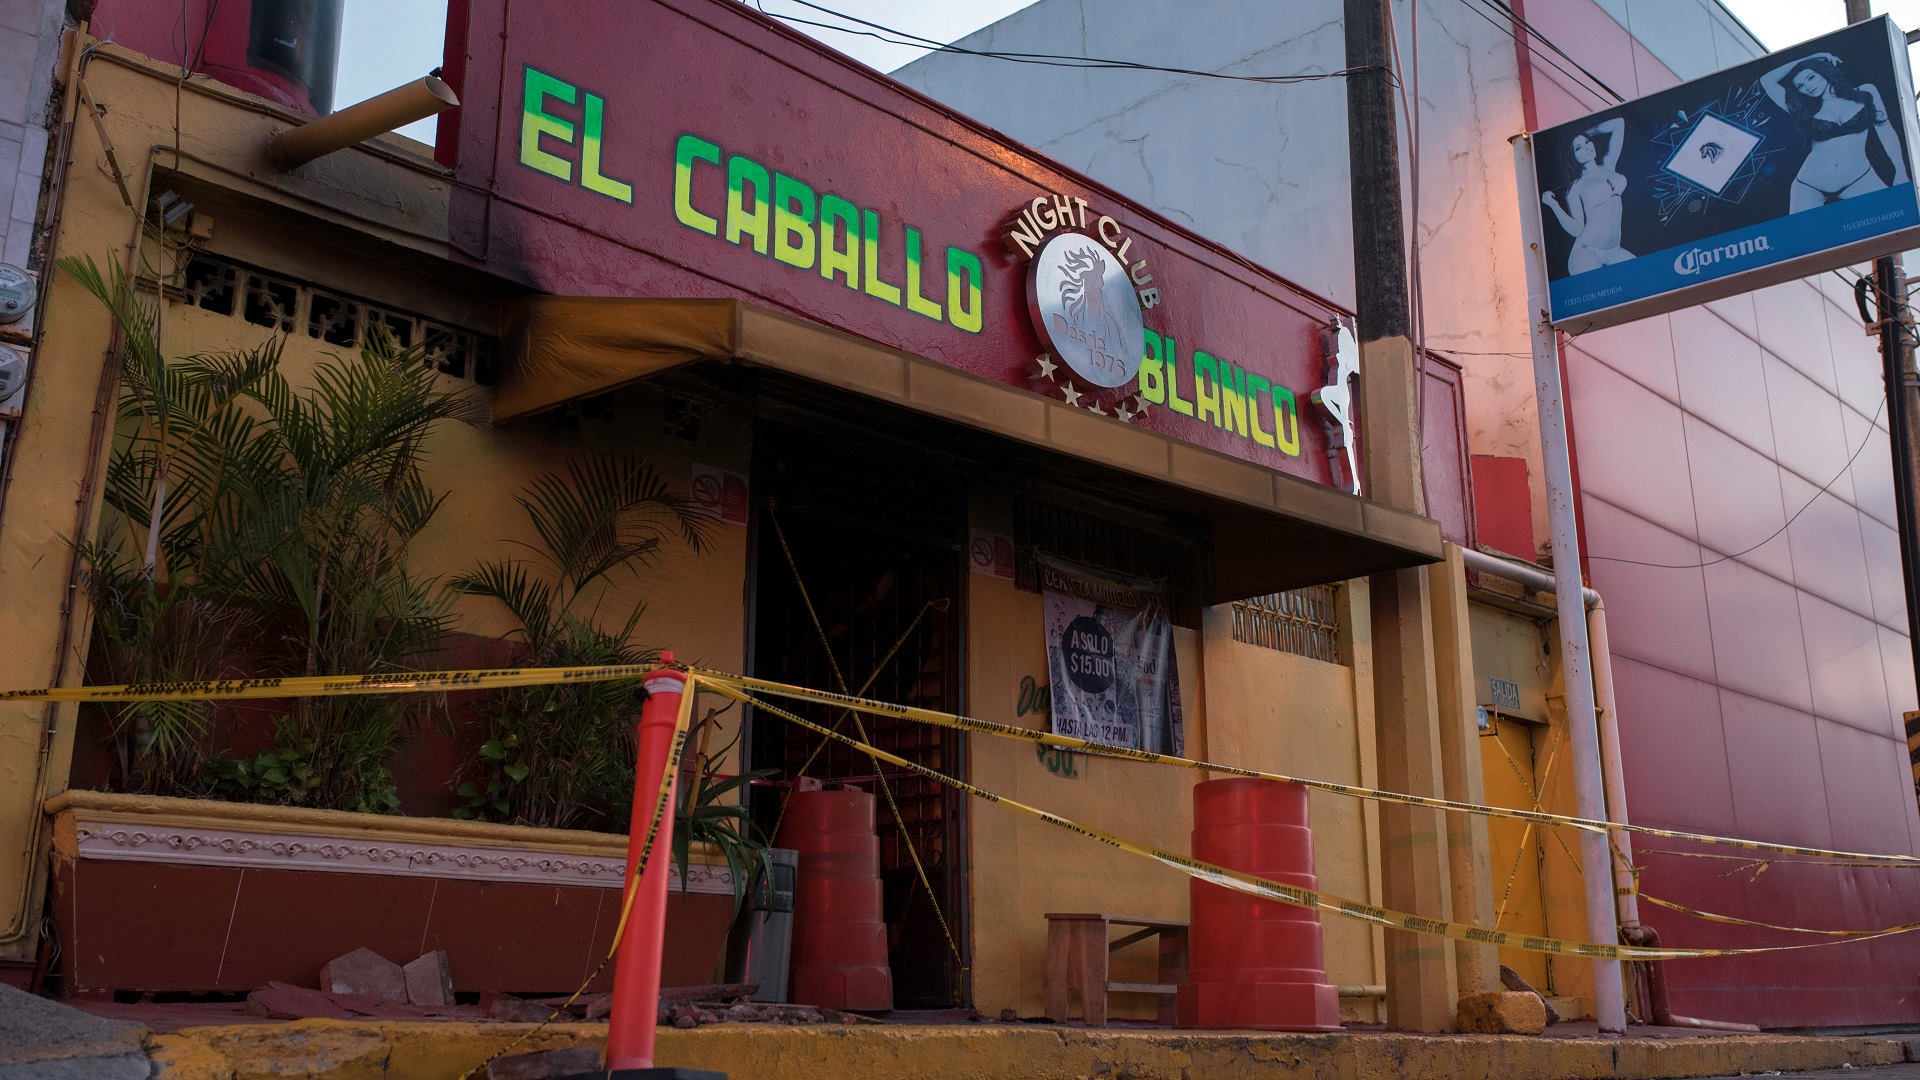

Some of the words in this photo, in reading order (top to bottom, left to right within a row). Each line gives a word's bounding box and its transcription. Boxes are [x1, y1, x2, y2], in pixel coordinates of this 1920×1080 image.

[519, 64, 634, 205] EL
[673, 132, 984, 334] CABALLO
[1010, 195, 1088, 258] NIGHT
[1098, 215, 1161, 309] CLUB
[1673, 236, 1771, 275] Corona
[1564, 297, 1581, 306] TODO
[1582, 293, 1597, 302] CON
[1597, 285, 1623, 297] MEDIDA
[1053, 312, 1106, 350] Desde
[1138, 326, 1300, 457] BLANCO
[1093, 583, 1138, 607] MODELO
[1070, 630, 1079, 649] A
[1080, 631, 1108, 655] SOLO
[1071, 653, 1110, 677] $15.00
[1491, 680, 1518, 700] SALIDA
[1056, 717, 1081, 735] HASTA
[1084, 720, 1098, 738] LAS
[1101, 724, 1110, 740] 12
[1112, 726, 1128, 742] PM.
